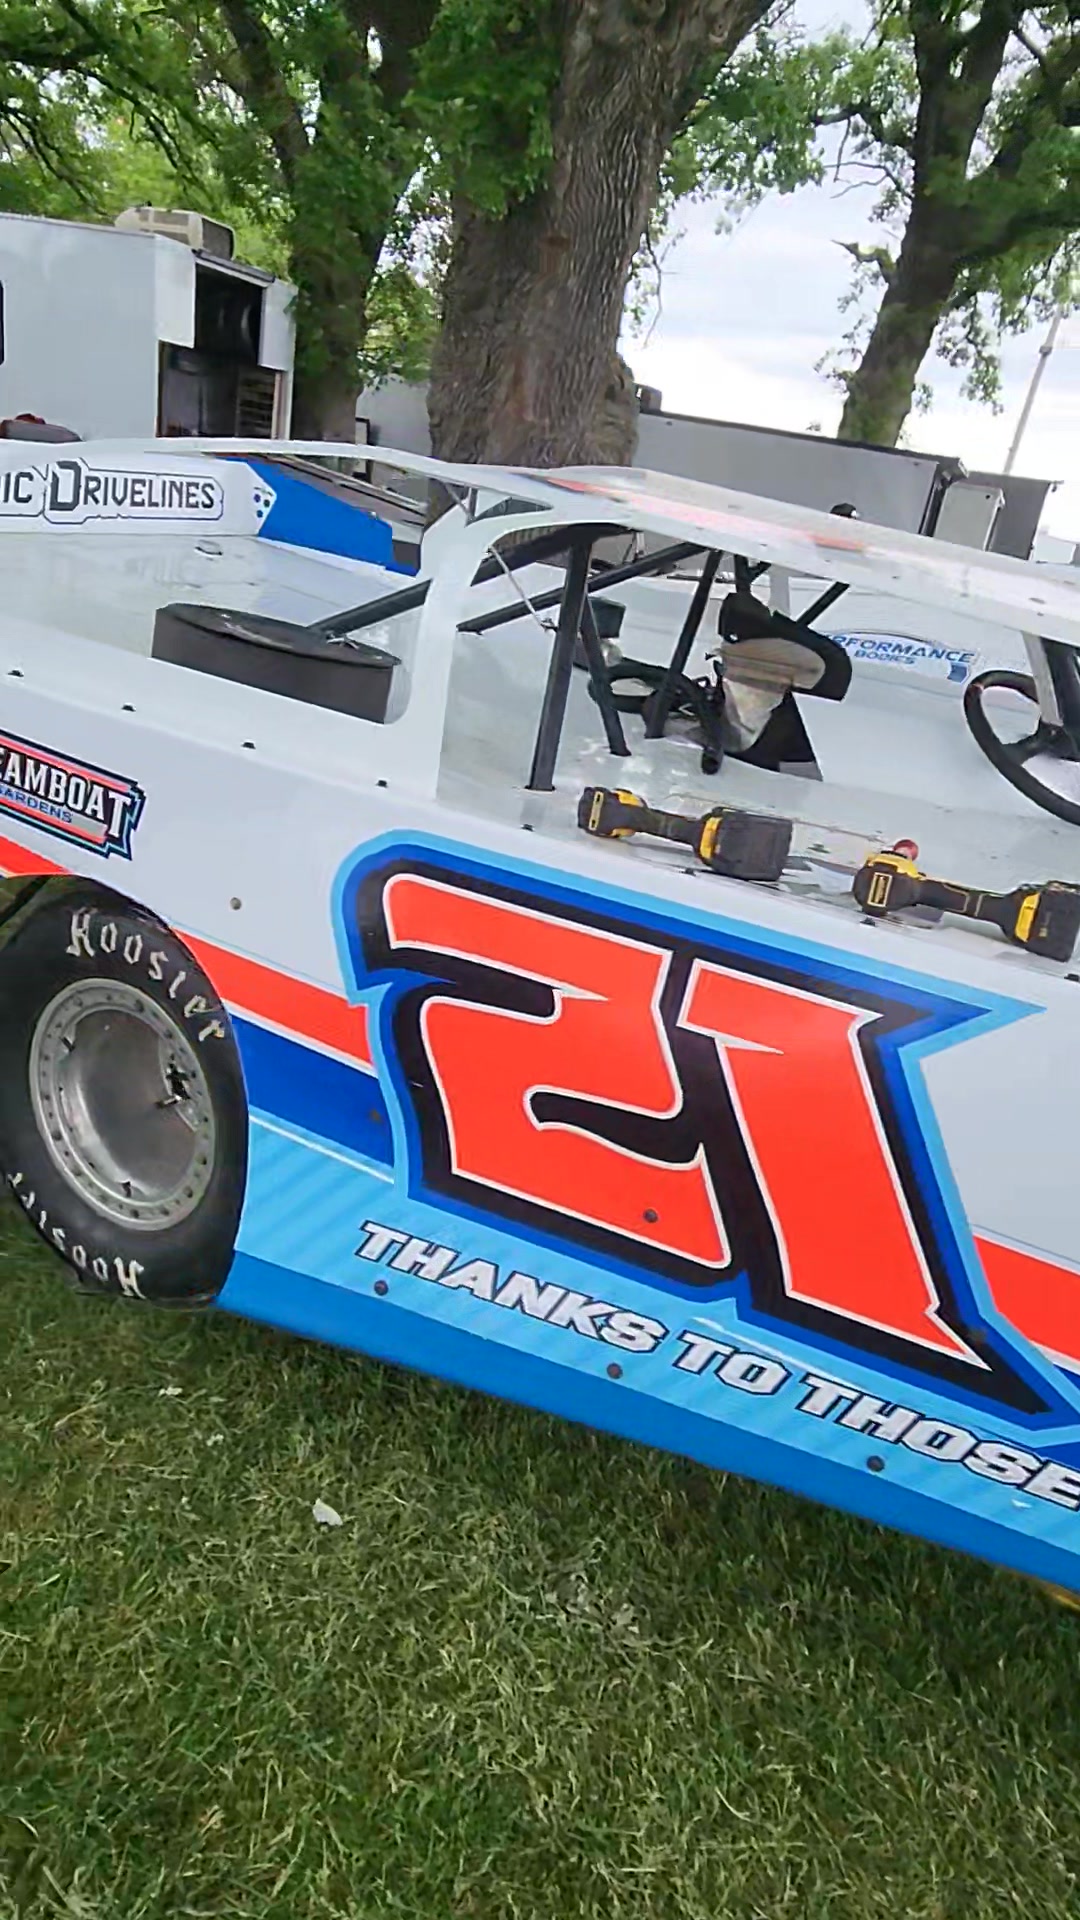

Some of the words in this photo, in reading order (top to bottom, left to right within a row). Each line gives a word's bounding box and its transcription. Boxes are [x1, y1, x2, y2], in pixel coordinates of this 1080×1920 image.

[49, 460, 215, 512] DRIVELINES
[826, 633, 976, 664] RFORMANCE
[381, 872, 994, 1371] 21
[355, 1220, 668, 1354] THANKS
[675, 1329, 792, 1397] TO
[798, 1373, 1080, 1511] THOSE
